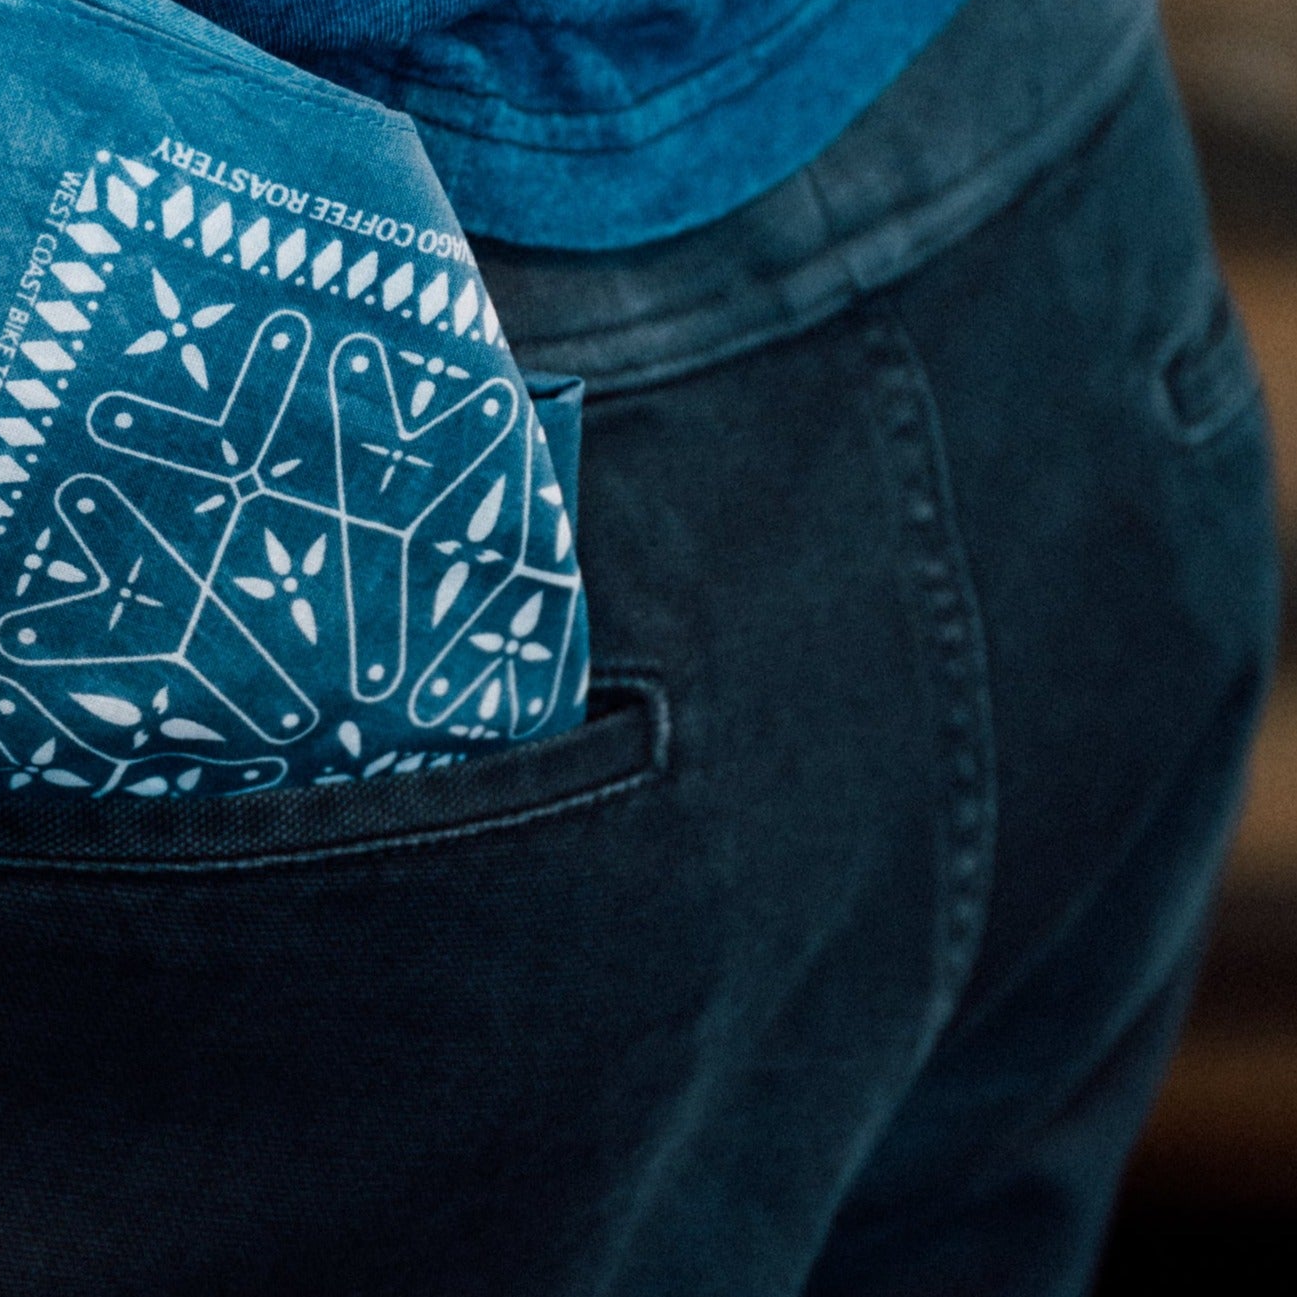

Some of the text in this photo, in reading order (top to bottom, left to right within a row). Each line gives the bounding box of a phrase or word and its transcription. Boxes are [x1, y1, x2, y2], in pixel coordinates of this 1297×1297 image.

[45, 171, 82, 234] WEST
[151, 136, 310, 215] ROASTERY
[309, 196, 416, 248] COFFEE
[16, 234, 57, 306] COAST
